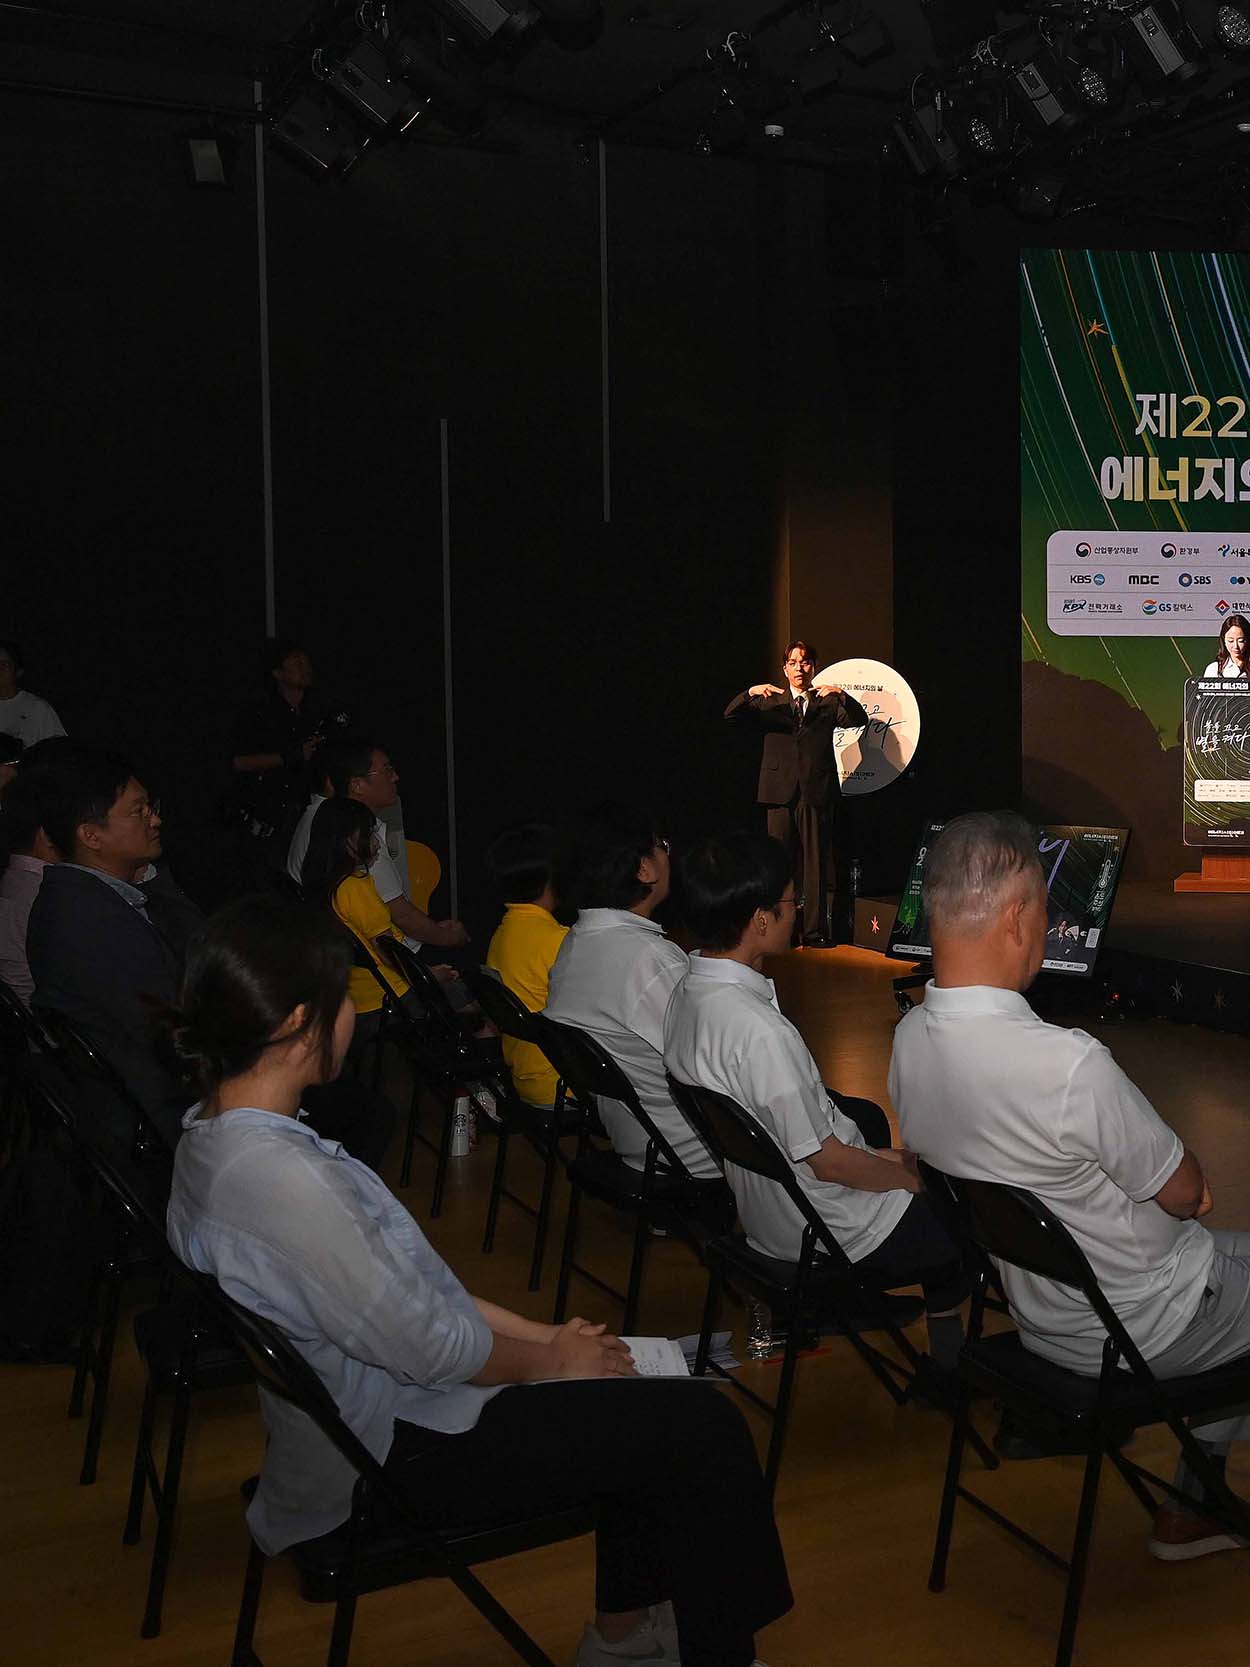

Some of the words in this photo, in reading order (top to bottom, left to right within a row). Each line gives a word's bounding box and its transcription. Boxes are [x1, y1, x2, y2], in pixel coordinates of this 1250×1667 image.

[1070, 575, 1092, 584] KBS
[1128, 575, 1160, 585] MBC
[1193, 575, 1212, 585] SBS
[1158, 603, 1172, 612] GS
